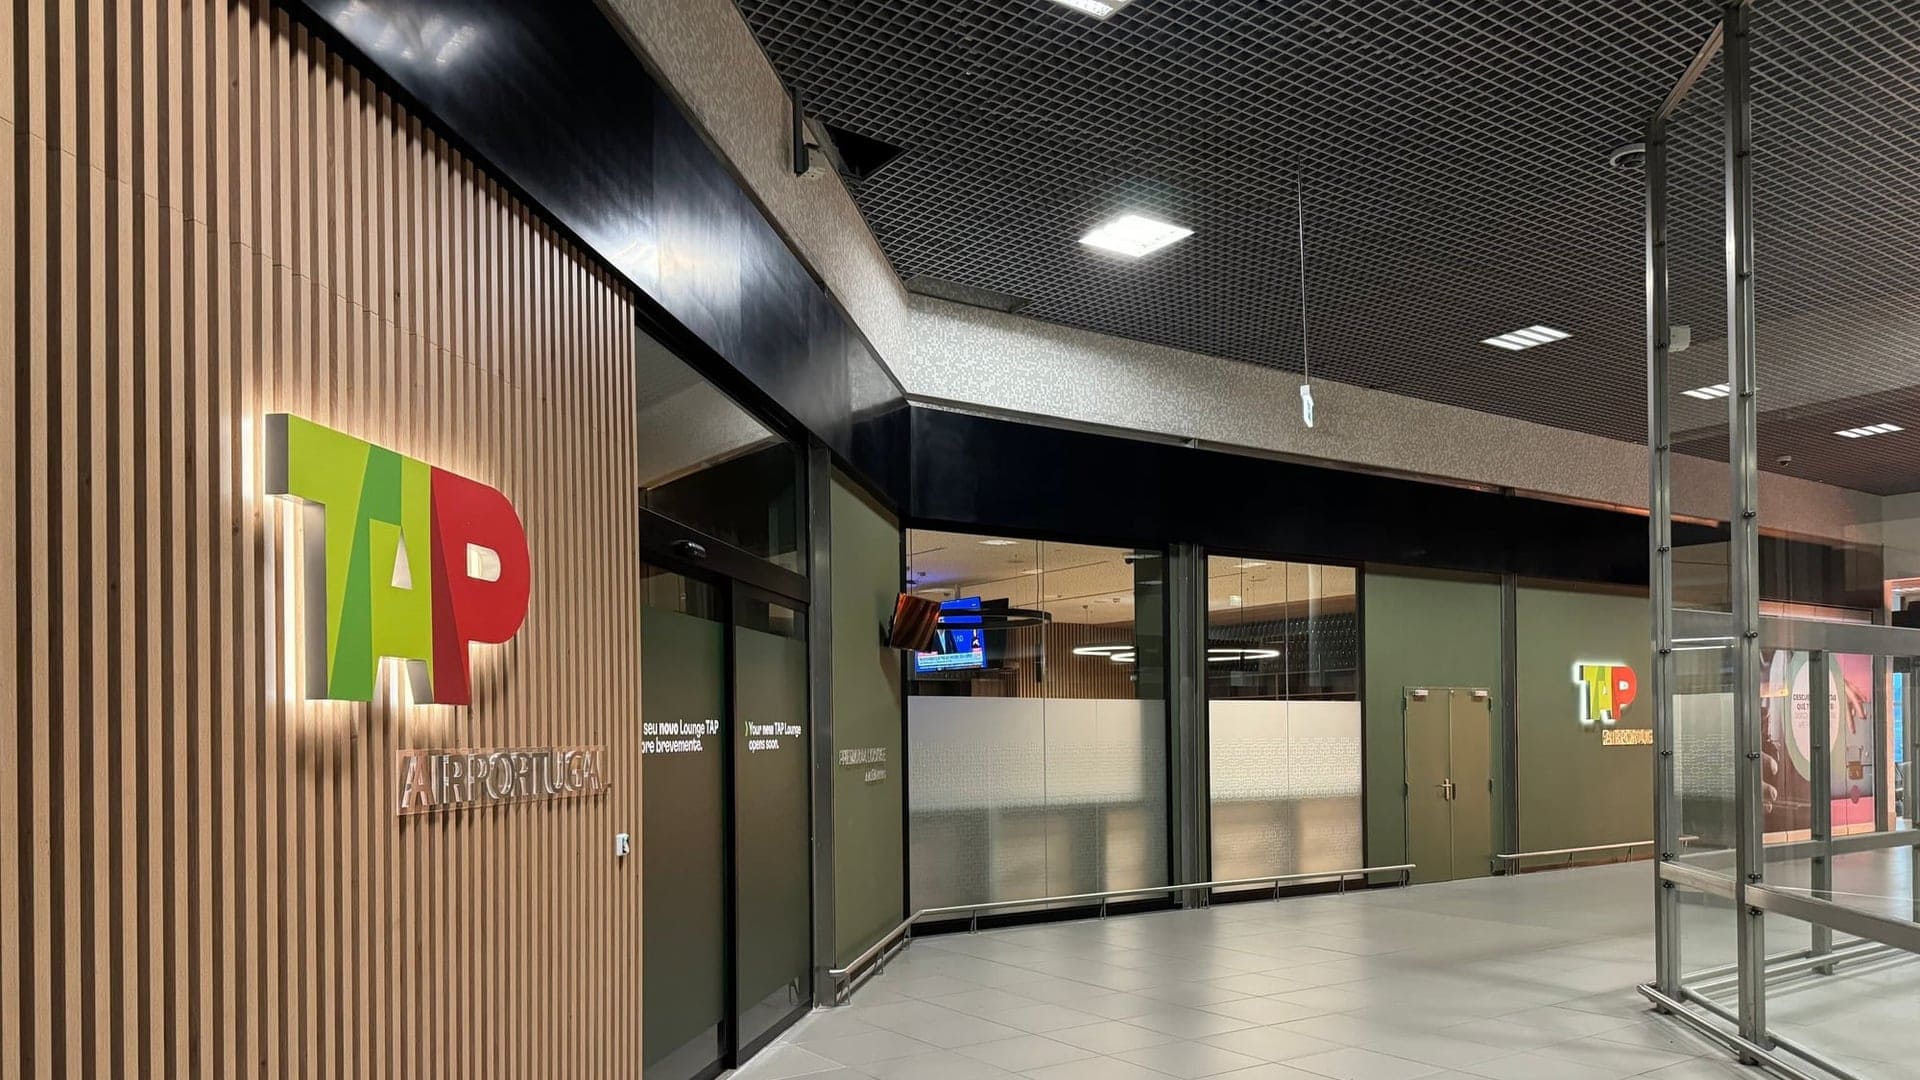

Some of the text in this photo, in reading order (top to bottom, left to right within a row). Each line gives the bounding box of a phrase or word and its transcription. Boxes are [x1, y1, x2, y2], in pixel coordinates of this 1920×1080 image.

[265, 413, 531, 706] TAP
[1578, 664, 1638, 721] TAP
[643, 719, 719, 738] seu novo Lounge TAP
[748, 721, 761, 735] Your
[774, 722, 784, 735] TAP
[785, 721, 801, 737] Lounge
[749, 739, 779, 753] opens soon.
